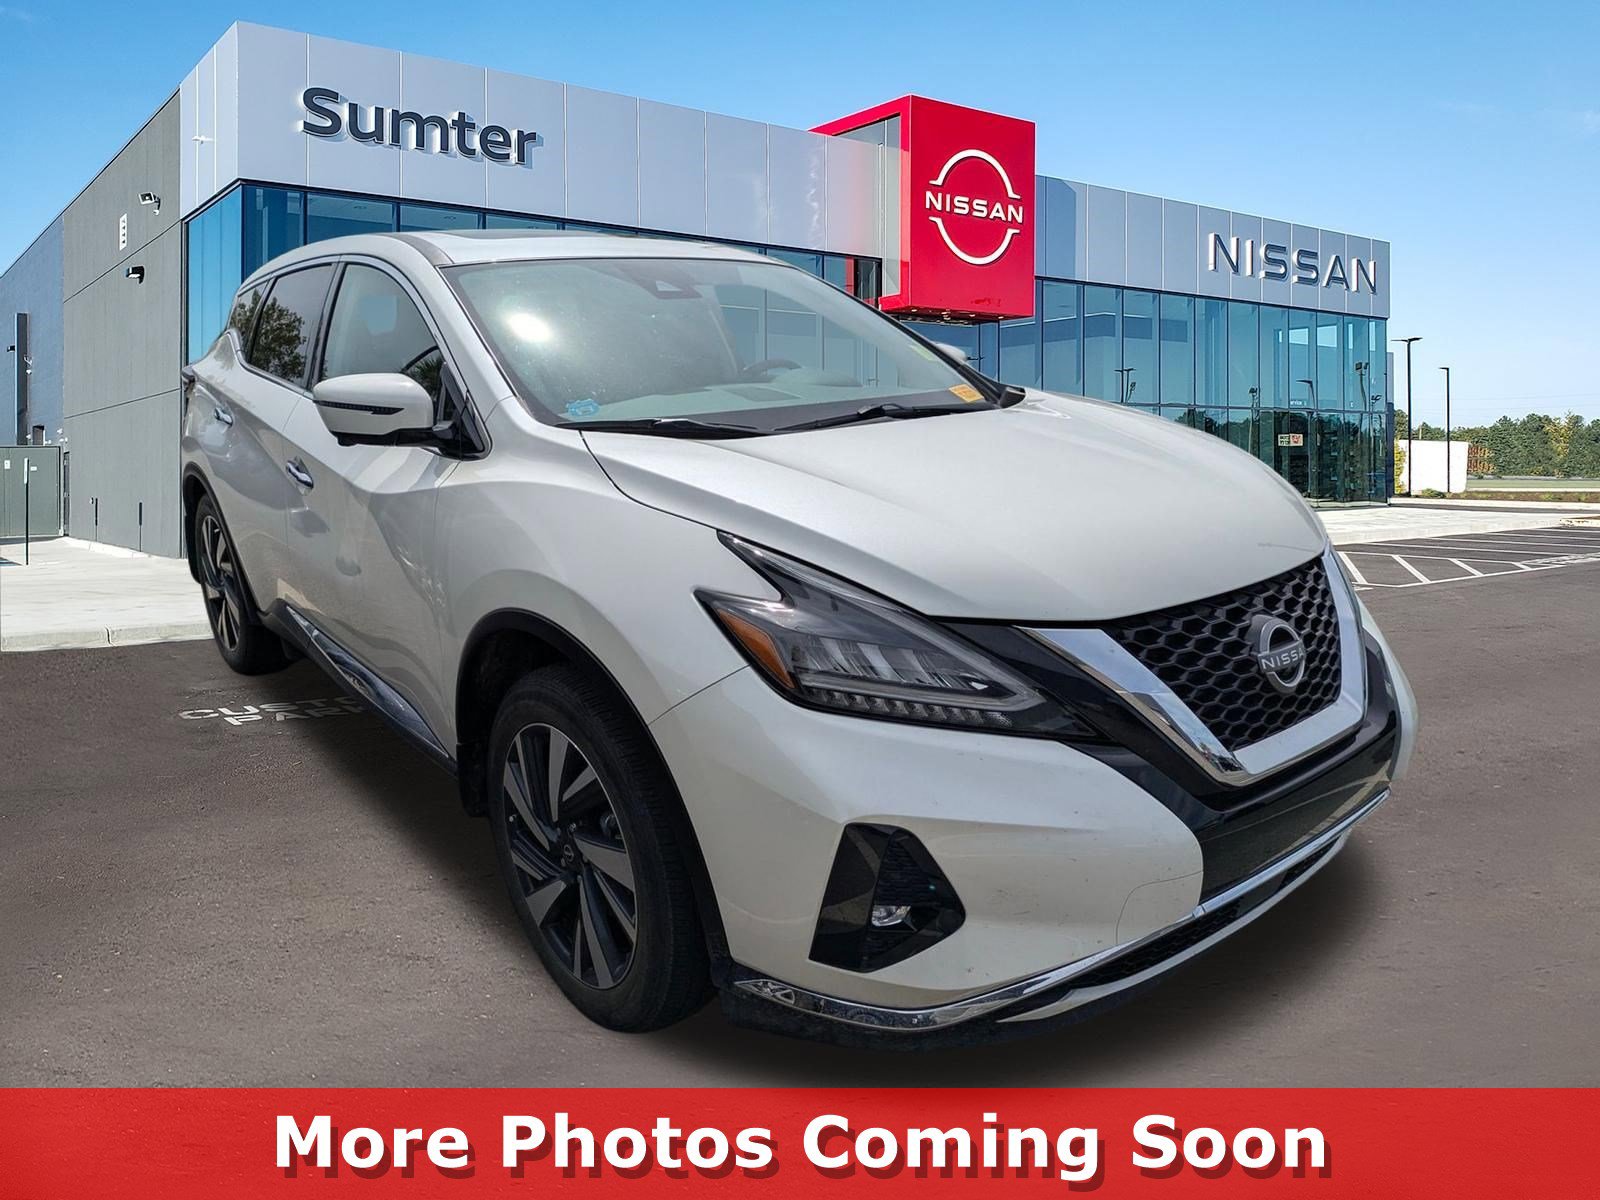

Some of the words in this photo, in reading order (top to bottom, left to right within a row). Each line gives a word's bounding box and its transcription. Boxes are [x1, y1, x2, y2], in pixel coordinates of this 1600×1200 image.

[300, 87, 537, 165] Sumter
[925, 190, 1023, 223] NISSAN
[1208, 232, 1377, 294] NISSAN
[1261, 647, 1305, 670] NISSA
